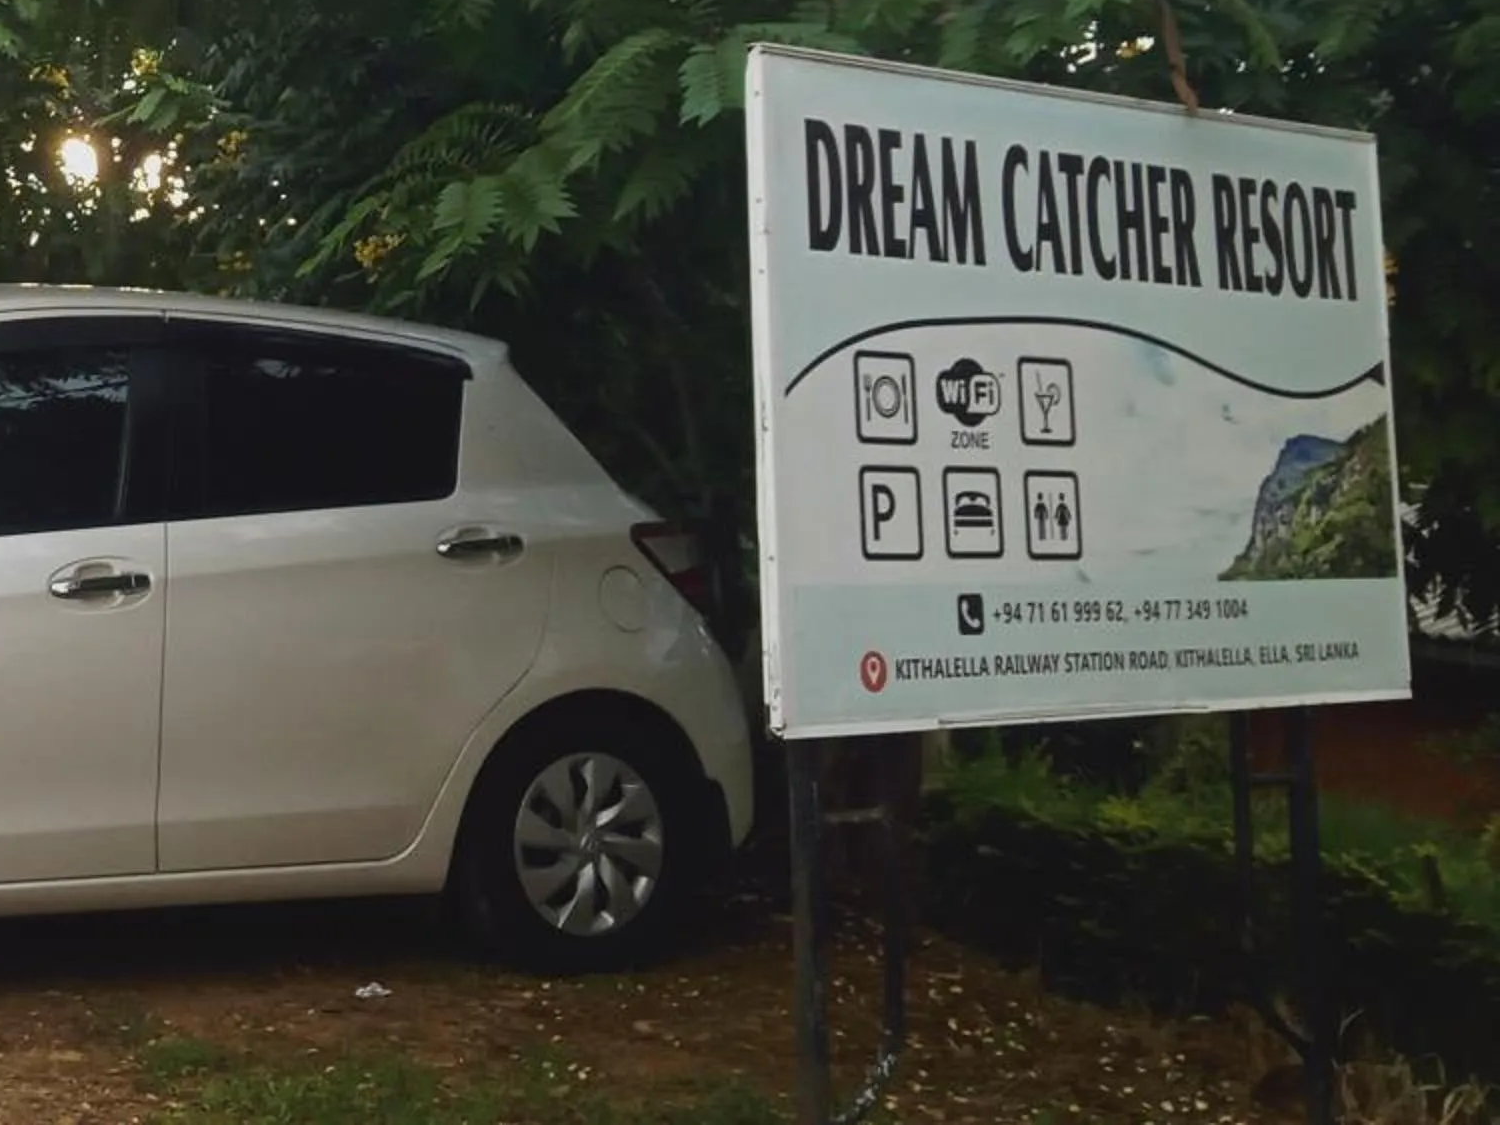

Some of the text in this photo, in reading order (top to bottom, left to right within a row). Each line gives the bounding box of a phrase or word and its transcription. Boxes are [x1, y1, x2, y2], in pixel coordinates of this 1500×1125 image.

[804, 118, 1358, 301] DREAM CATCHER RESORT
[951, 431, 990, 449] ZONE
[872, 484, 896, 541] P
[993, 602, 1021, 623] +94
[1027, 602, 1045, 623] 71
[1051, 602, 1068, 622] 61
[1074, 601, 1101, 622] 999
[1134, 600, 1160, 622] +94
[1165, 600, 1182, 620] 77
[1187, 600, 1211, 619] 349
[1216, 599, 1248, 619] 1004
[895, 655, 989, 680] KITHALELLA
[994, 654, 1060, 675] RAILWAY
[1064, 651, 1125, 673] STATION
[1296, 643, 1315, 662] SRI
[1319, 641, 1360, 661] LANKA
